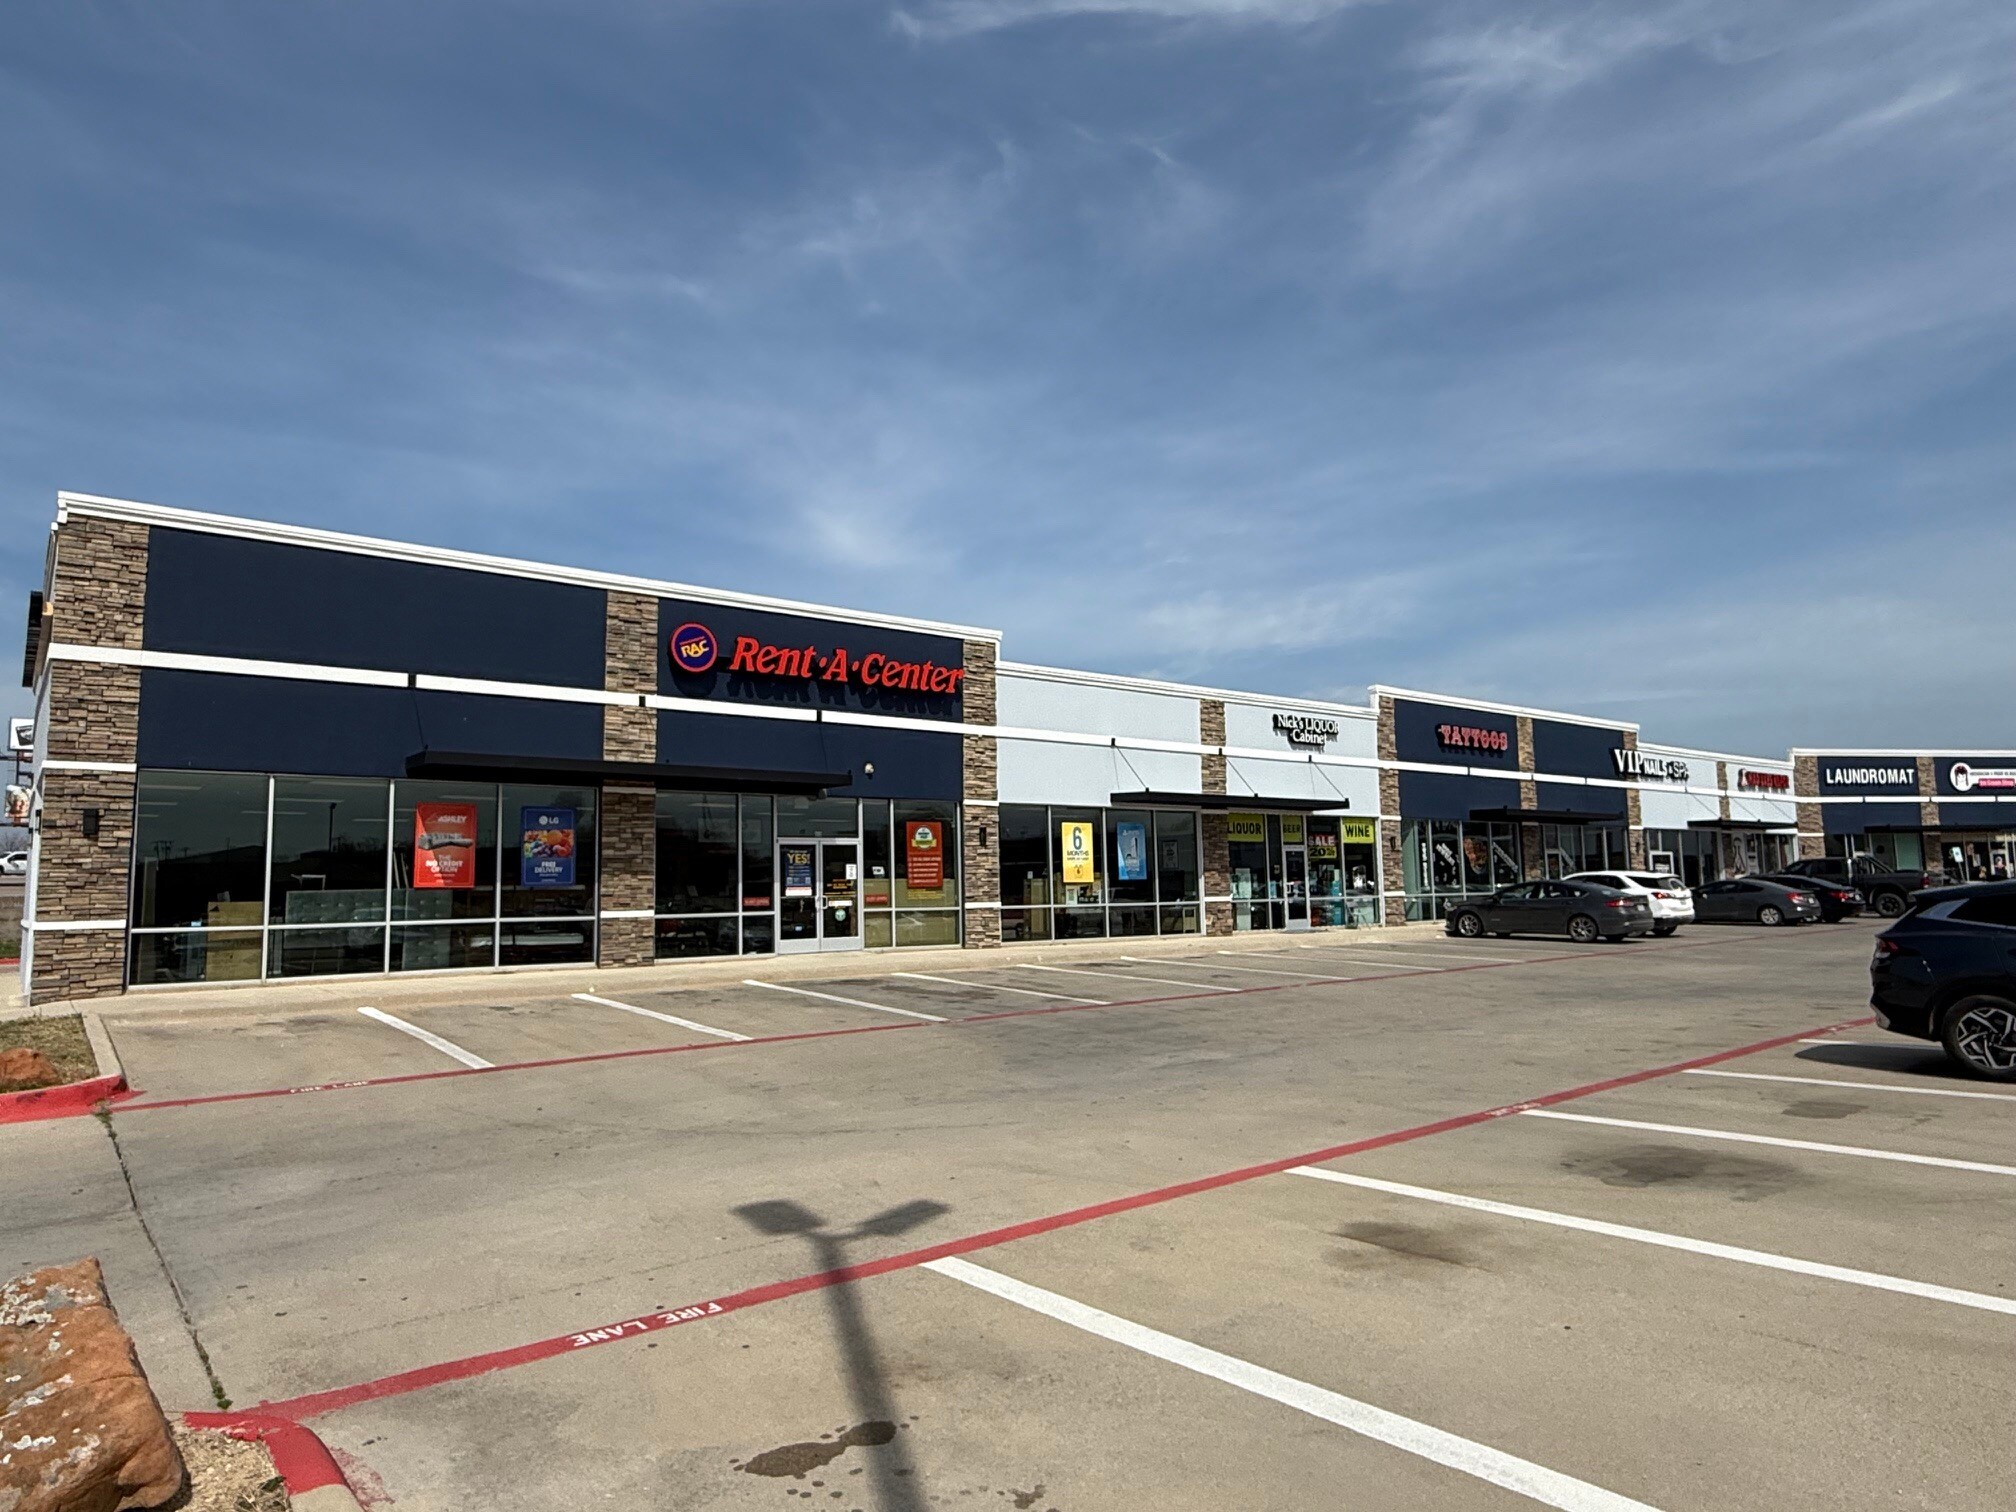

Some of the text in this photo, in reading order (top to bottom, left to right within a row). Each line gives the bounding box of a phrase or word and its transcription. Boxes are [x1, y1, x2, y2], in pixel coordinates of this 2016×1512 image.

[681, 640, 710, 658] RAC
[1305, 717, 1340, 734] LIQUOR
[1292, 729, 1327, 744] Cabinet
[1438, 725, 1508, 751] TATTOOS
[1614, 749, 1643, 773] VIP
[1643, 759, 1667, 776] NAILS
[1826, 768, 1915, 785] LAUNDROMAT
[1227, 821, 1262, 834] LIQUOR
[1283, 824, 1300, 834] BEER
[1345, 824, 1371, 838] WINE
[1072, 826, 1083, 851] 6
[1308, 835, 1336, 847] SALE
[568, 1302, 724, 1347] FIRE LANE
